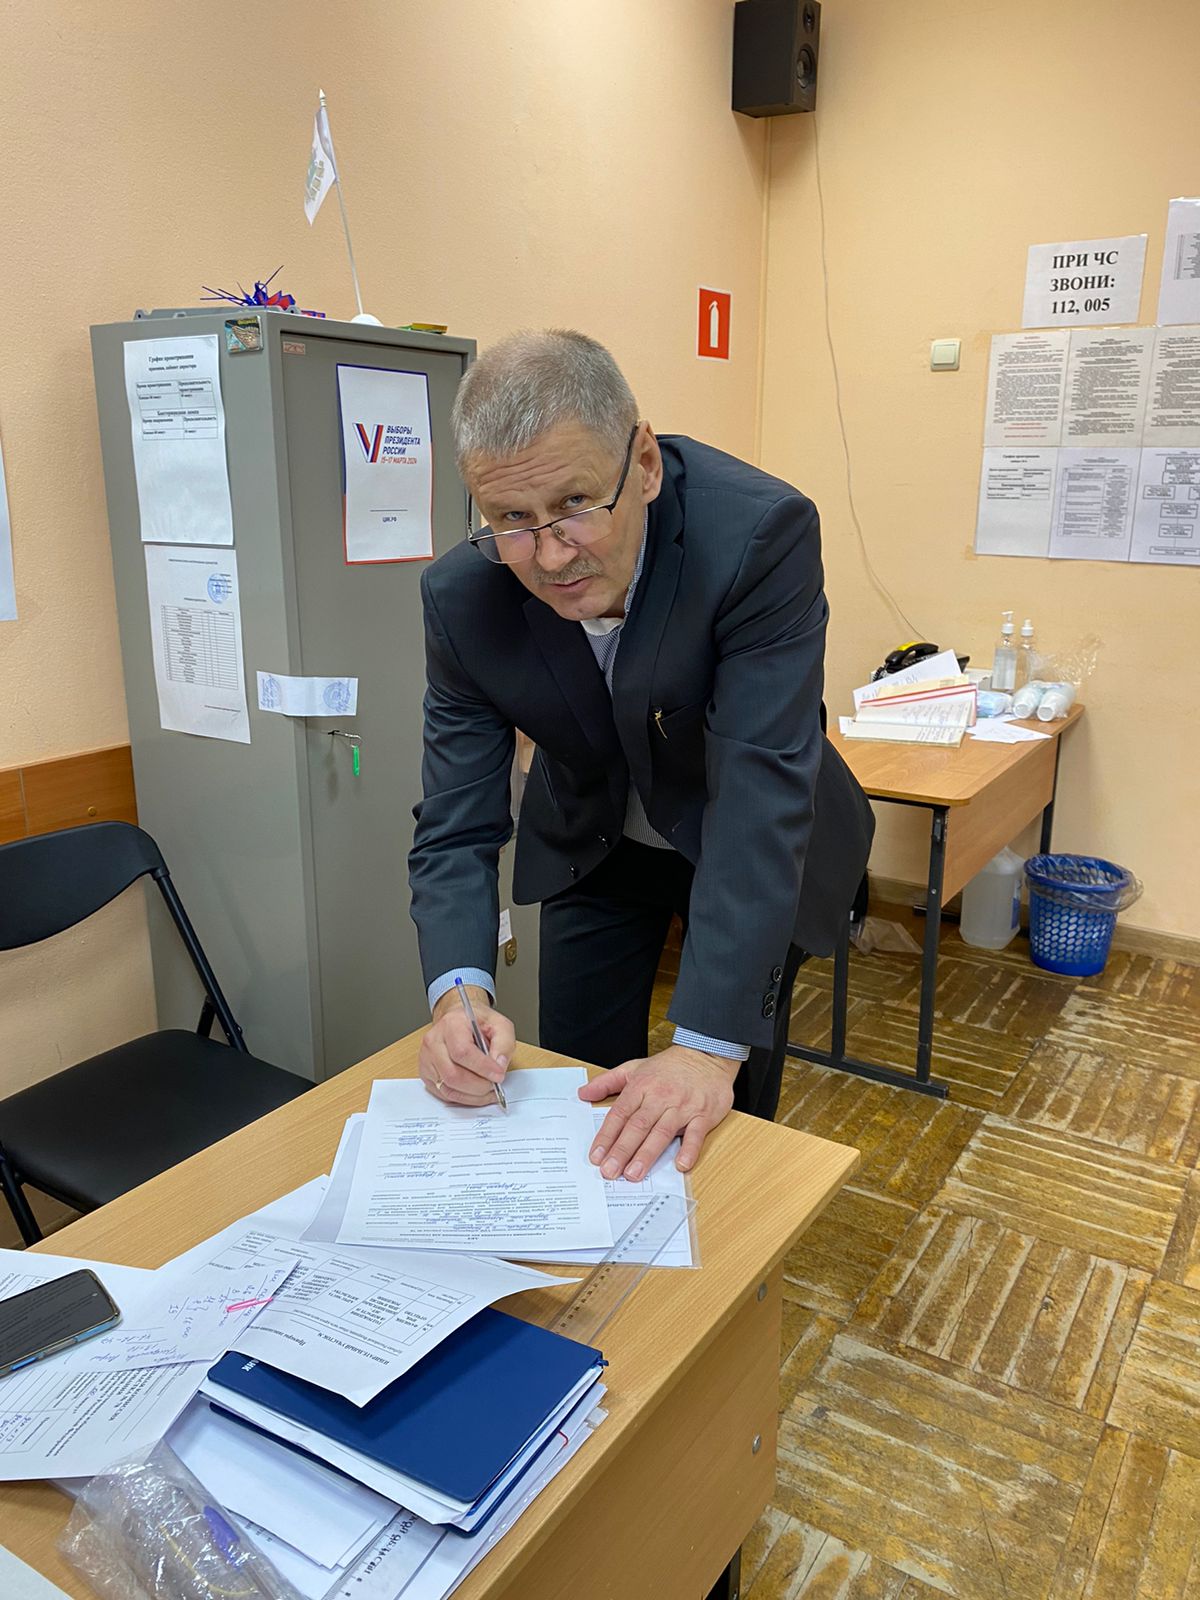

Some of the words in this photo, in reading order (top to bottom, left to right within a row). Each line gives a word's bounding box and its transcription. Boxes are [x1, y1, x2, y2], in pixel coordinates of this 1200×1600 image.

[1052, 253, 1090, 270] ПРИ
[1094, 250, 1119, 266] ЧС
[1049, 274, 1116, 292] ЗВОНИ:
[1052, 300, 1080, 315] 112,
[1084, 297, 1110, 312] 005
[386, 425, 412, 434] ВЫБОРЫ
[384, 436, 421, 446] ПРЕЗИДЕНТА
[382, 446, 407, 455] РОССИИ
[345, 1344, 390, 1366] ИЗБИРАТЕЛЬНЫЙ
